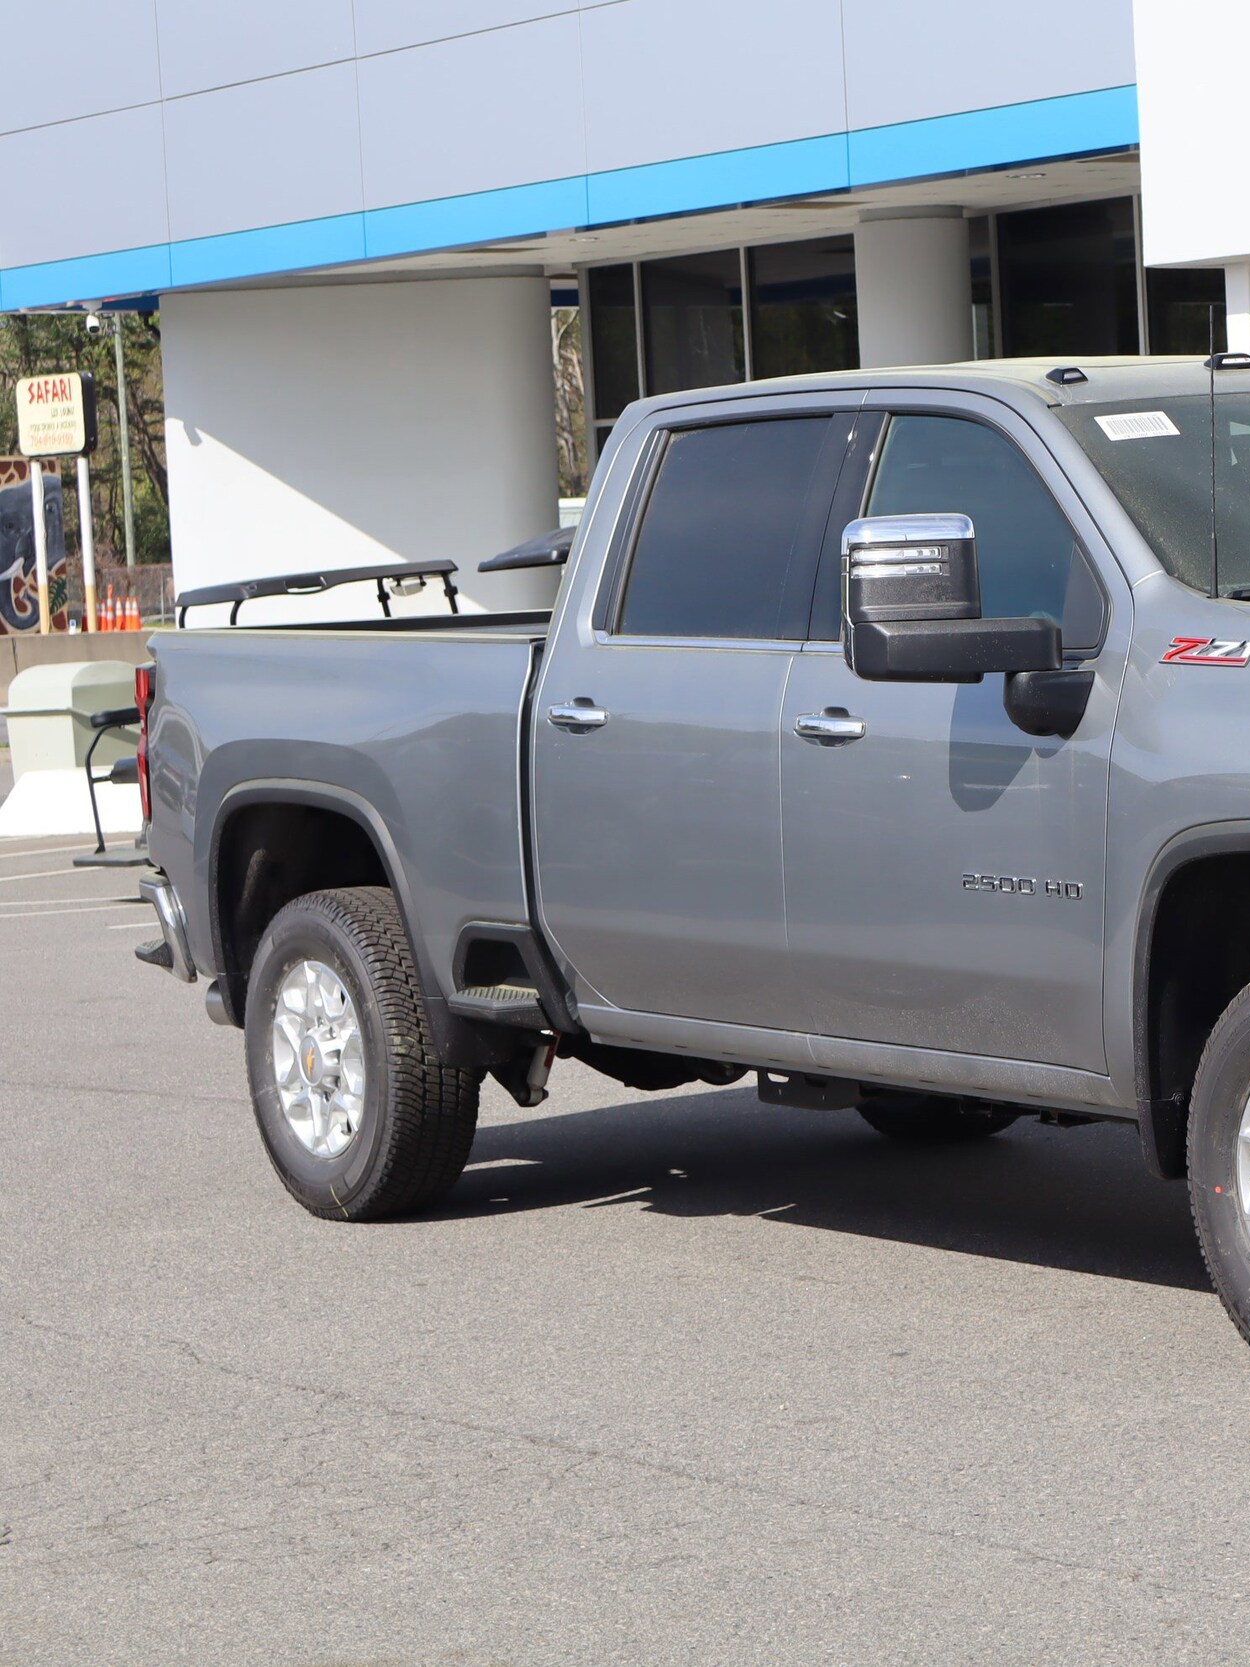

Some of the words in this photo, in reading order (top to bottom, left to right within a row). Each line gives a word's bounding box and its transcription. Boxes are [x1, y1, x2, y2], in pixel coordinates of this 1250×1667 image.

[28, 377, 72, 405] SAFARI
[962, 872, 1036, 895] 2500
[1045, 879, 1083, 900] HD
